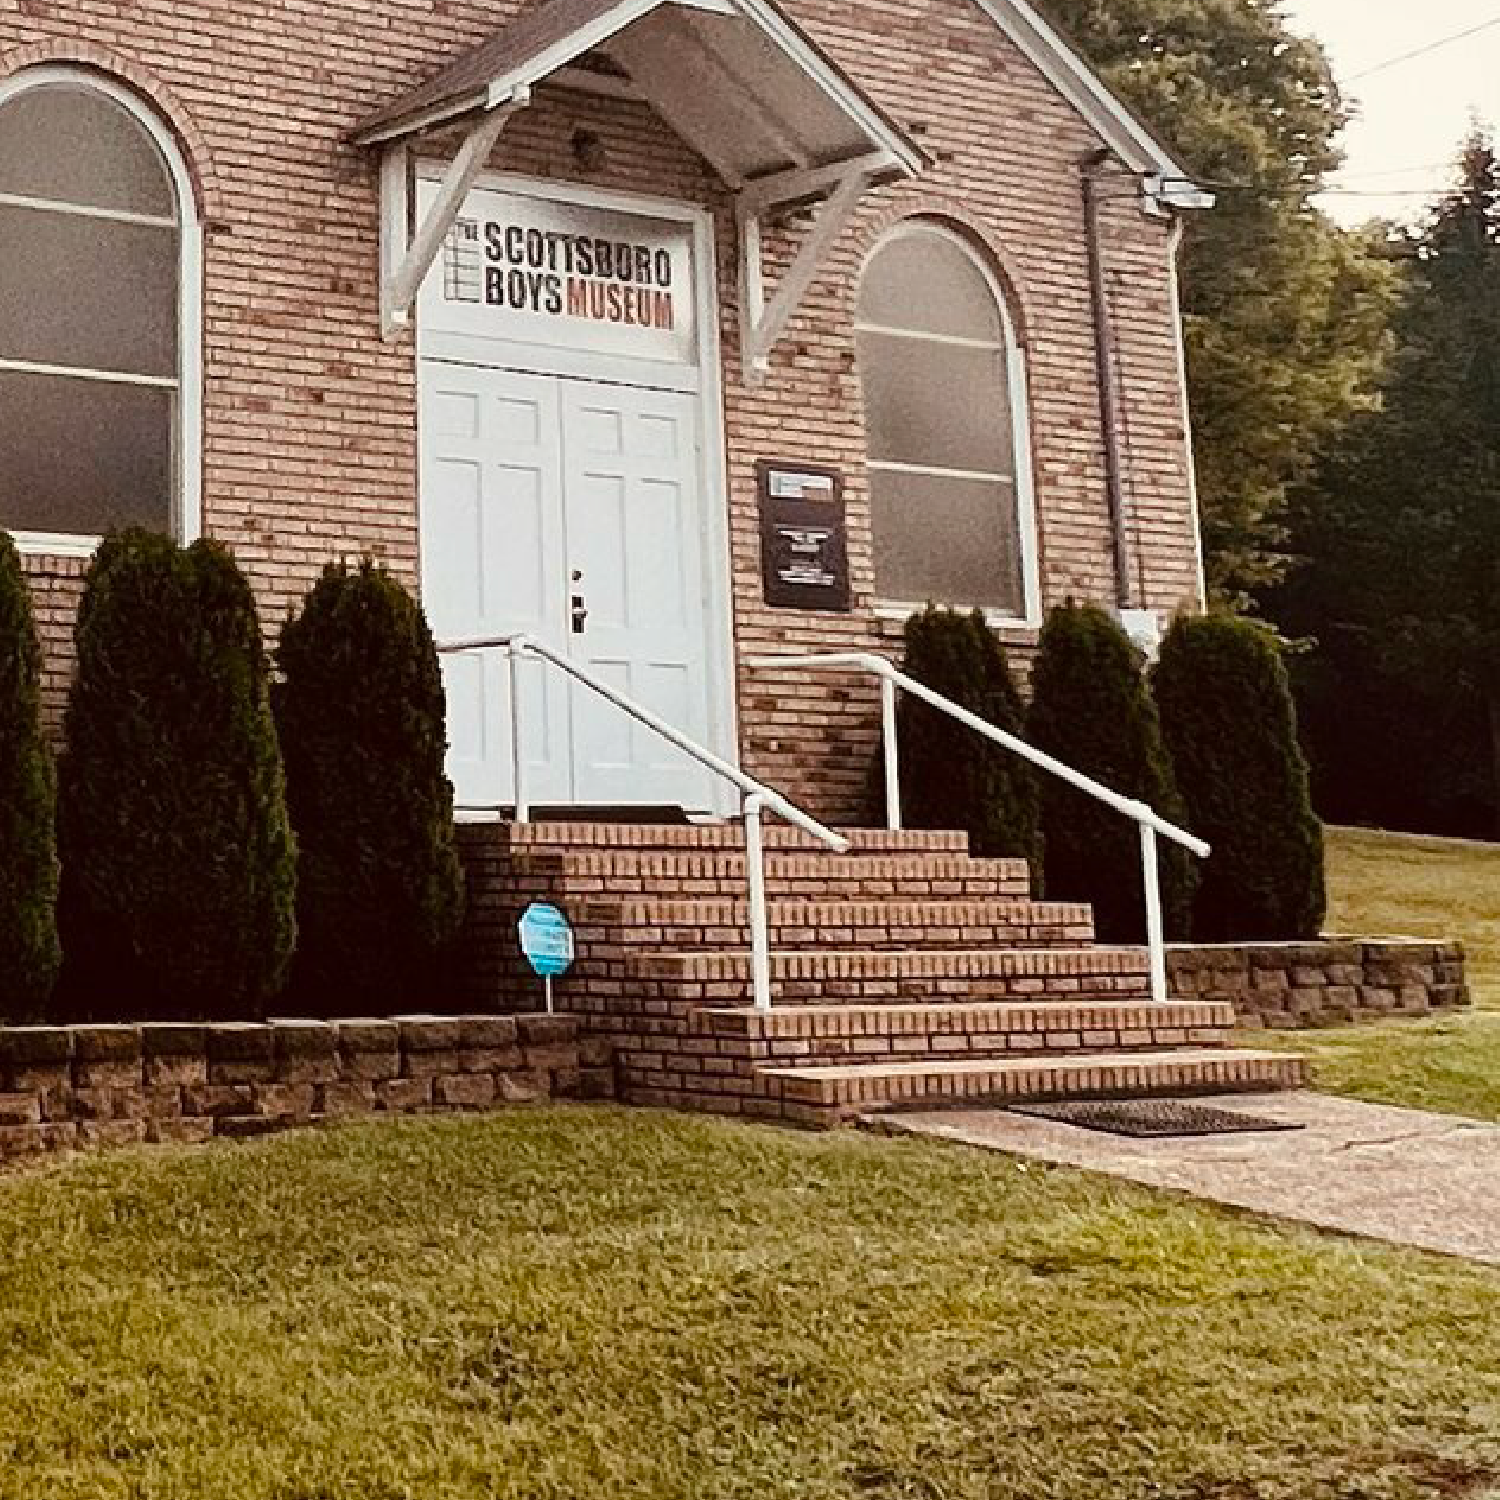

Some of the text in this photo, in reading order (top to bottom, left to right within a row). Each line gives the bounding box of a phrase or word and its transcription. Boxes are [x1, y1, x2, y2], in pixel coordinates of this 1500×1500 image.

[484, 221, 672, 287] SCOTTSBORO
[484, 265, 675, 331] BOYS MUSEUM
